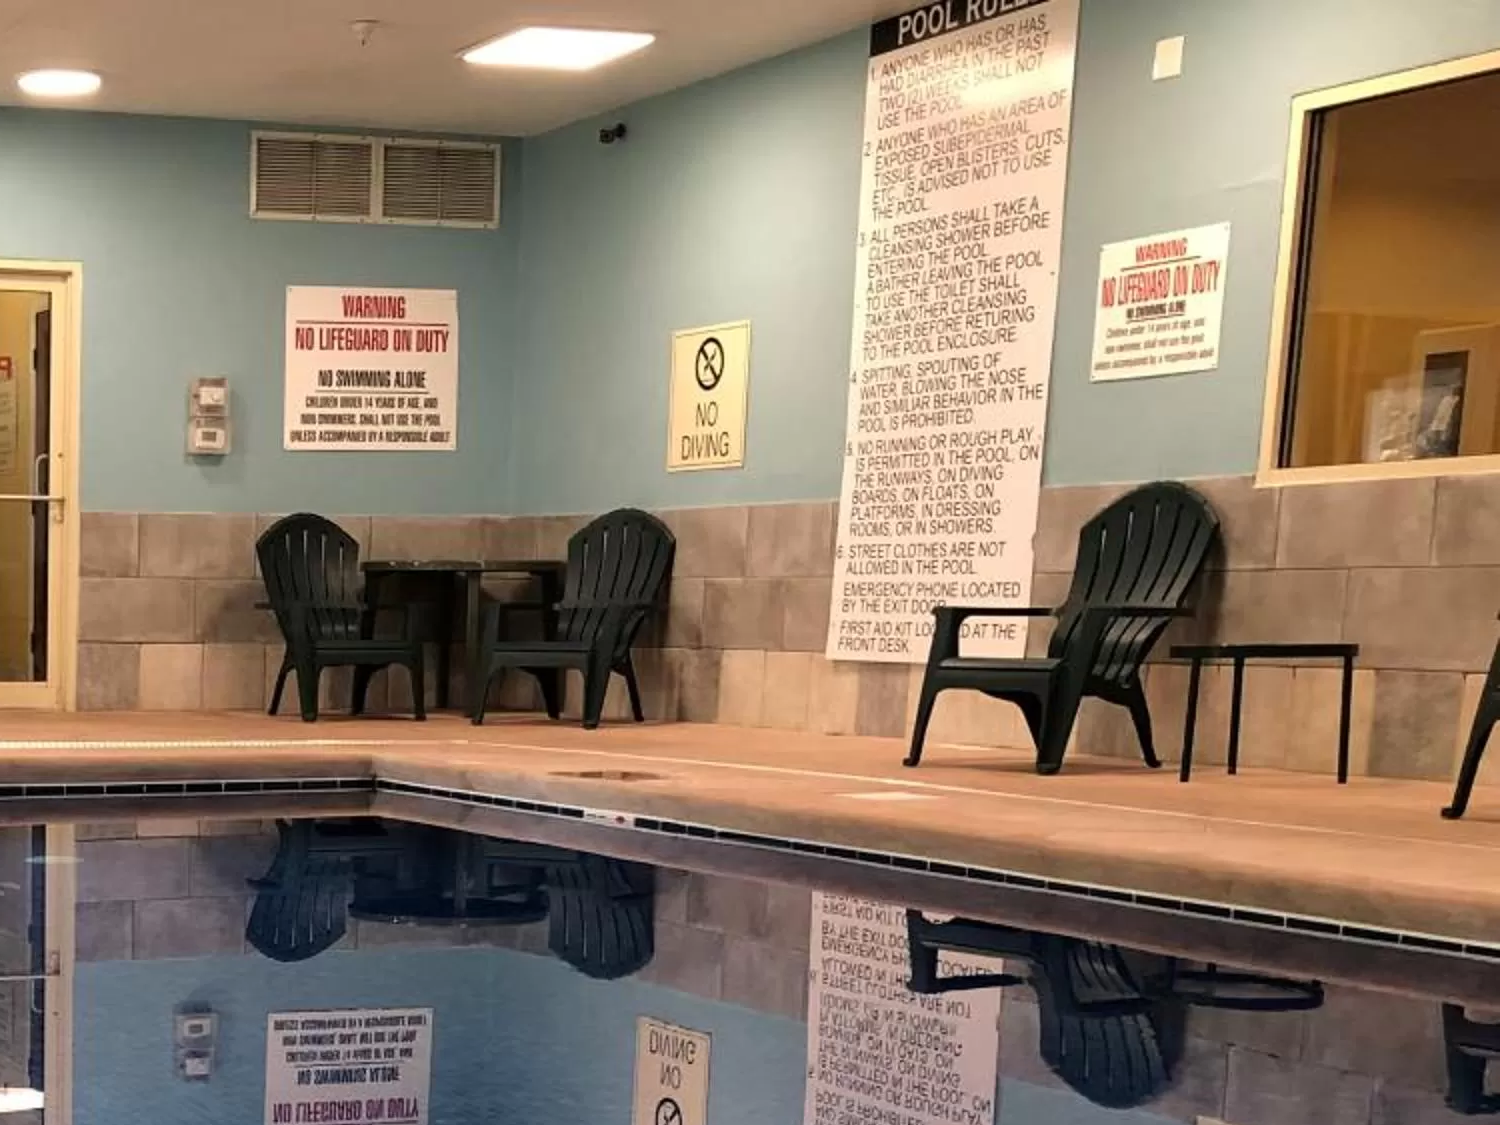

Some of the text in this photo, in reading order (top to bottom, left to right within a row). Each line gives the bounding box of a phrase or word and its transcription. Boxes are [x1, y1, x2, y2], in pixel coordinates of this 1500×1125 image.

[898, 4, 959, 45] POOL
[881, 12, 1046, 78] ANYONE WHO HAS OR HAS
[1016, 30, 1050, 56] PAST
[1015, 50, 1044, 74] NOT
[876, 126, 925, 154] ANYONE
[927, 117, 957, 141] WHO
[1009, 93, 1045, 119] AREA
[1048, 87, 1068, 109] OF
[877, 103, 927, 131] USE THE
[874, 142, 930, 170] EXPOSED
[920, 154, 953, 177] OPEN
[904, 148, 1052, 197] IS ADVISED NOT TO USE
[870, 194, 1039, 244] ALL PERSONS SHALL TAKE A
[871, 203, 893, 222] THE
[868, 211, 1051, 261] CLEANSING SHOWER BEFORE
[867, 248, 950, 278] ENTERING THE
[1135, 237, 1188, 263] WARNING
[866, 248, 1044, 294] A BATHER LEAVING THE POOL
[1102, 260, 1220, 308] NO LIFEGUARD ON DUTY
[865, 272, 1021, 311] TO USE THE TOILET SHALL
[342, 295, 406, 319] WARNING
[894, 301, 948, 324] ANOTHER
[951, 288, 1027, 315] CLEANSING
[863, 305, 1035, 345] SHOWER BEFORE RETURING
[295, 327, 449, 353] NO LIFEGUARD ON DUTY
[862, 345, 876, 361] TO
[879, 342, 901, 359] THE
[903, 337, 935, 356] POOL
[917, 352, 1002, 376] SPOUTING OF
[318, 370, 427, 389] NO SWIMMING ALONE
[901, 375, 956, 395] BLOWING
[960, 371, 985, 389] THE
[988, 366, 1027, 386] NOSE
[859, 400, 880, 416] AND
[933, 388, 997, 409] BEHAVIOR
[999, 386, 1014, 403] IN
[1016, 383, 1044, 401] THE
[696, 401, 719, 428] NO
[858, 416, 886, 433] POOL
[890, 415, 899, 430] IS
[681, 431, 729, 461] DIVING
[856, 426, 1033, 456] NO RUNNING OR ROUGH PLAY
[855, 457, 865, 472] IS
[867, 452, 930, 471] PERMITTED
[933, 451, 944, 466] IN
[948, 449, 972, 465] THE
[1019, 444, 1039, 461] ON
[854, 464, 1004, 488] THE ON DIVING
[903, 487, 919, 502] ON
[975, 483, 995, 498] ON
[921, 503, 933, 518] IN
[935, 500, 1001, 518] DRESSING
[895, 521, 912, 535] OR
[915, 520, 926, 535] IN
[848, 541, 1006, 558] STREET CLOTHES ARE NOT
[845, 560, 938, 575] ALLOWED IN THE
[843, 582, 1021, 598] EMERGENCY PHONE LOCATED
[841, 599, 908, 614] BY THE EXIT
[839, 621, 871, 635] FIRST
[873, 621, 891, 636] AID
[894, 622, 912, 636] KIT
[971, 623, 988, 638] AT
[991, 623, 1016, 639] THE
[837, 636, 875, 652] FRONT
